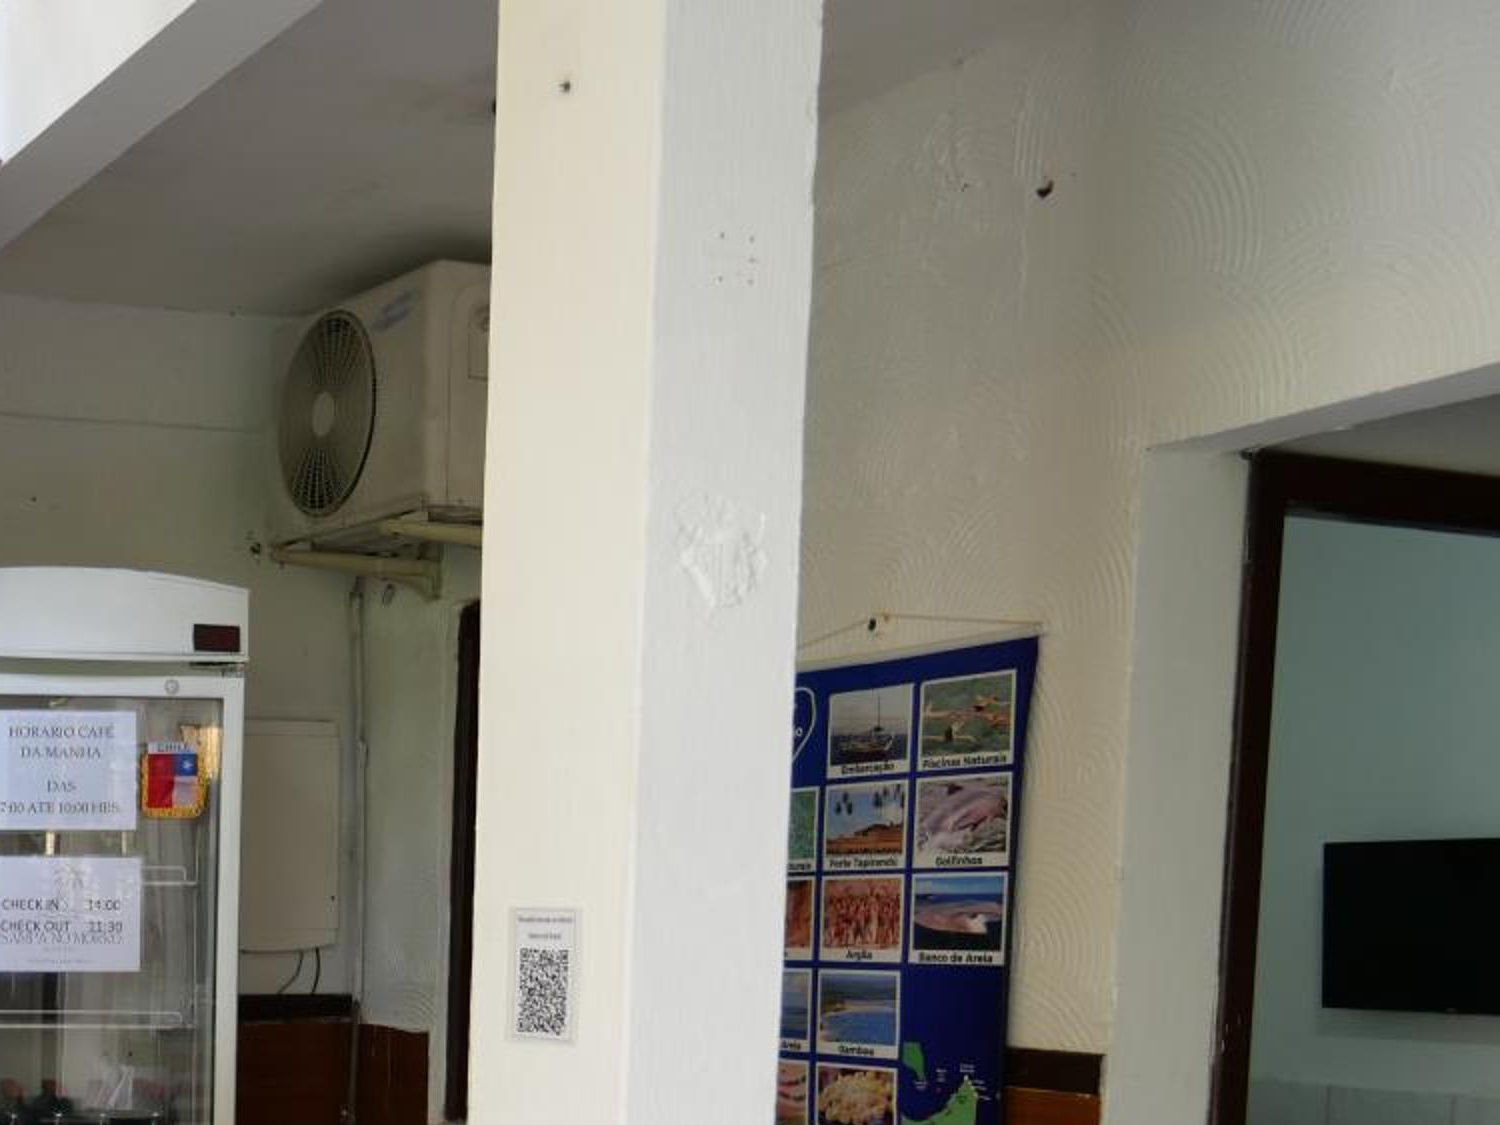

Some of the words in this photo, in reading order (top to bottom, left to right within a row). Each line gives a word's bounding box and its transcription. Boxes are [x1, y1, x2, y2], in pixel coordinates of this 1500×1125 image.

[8, 725, 74, 739] HORARIO
[20, 746, 42, 759] DA
[963, 754, 1007, 766] Naturais
[47, 779, 77, 793] DAS
[935, 856, 983, 866] Golfinhos
[1, 898, 43, 911] CHECK
[0, 919, 41, 932] CHECK
[43, 921, 70, 932] OUT
[919, 951, 948, 962] Banco
[949, 952, 962, 962] de
[965, 953, 993, 963] Areia
